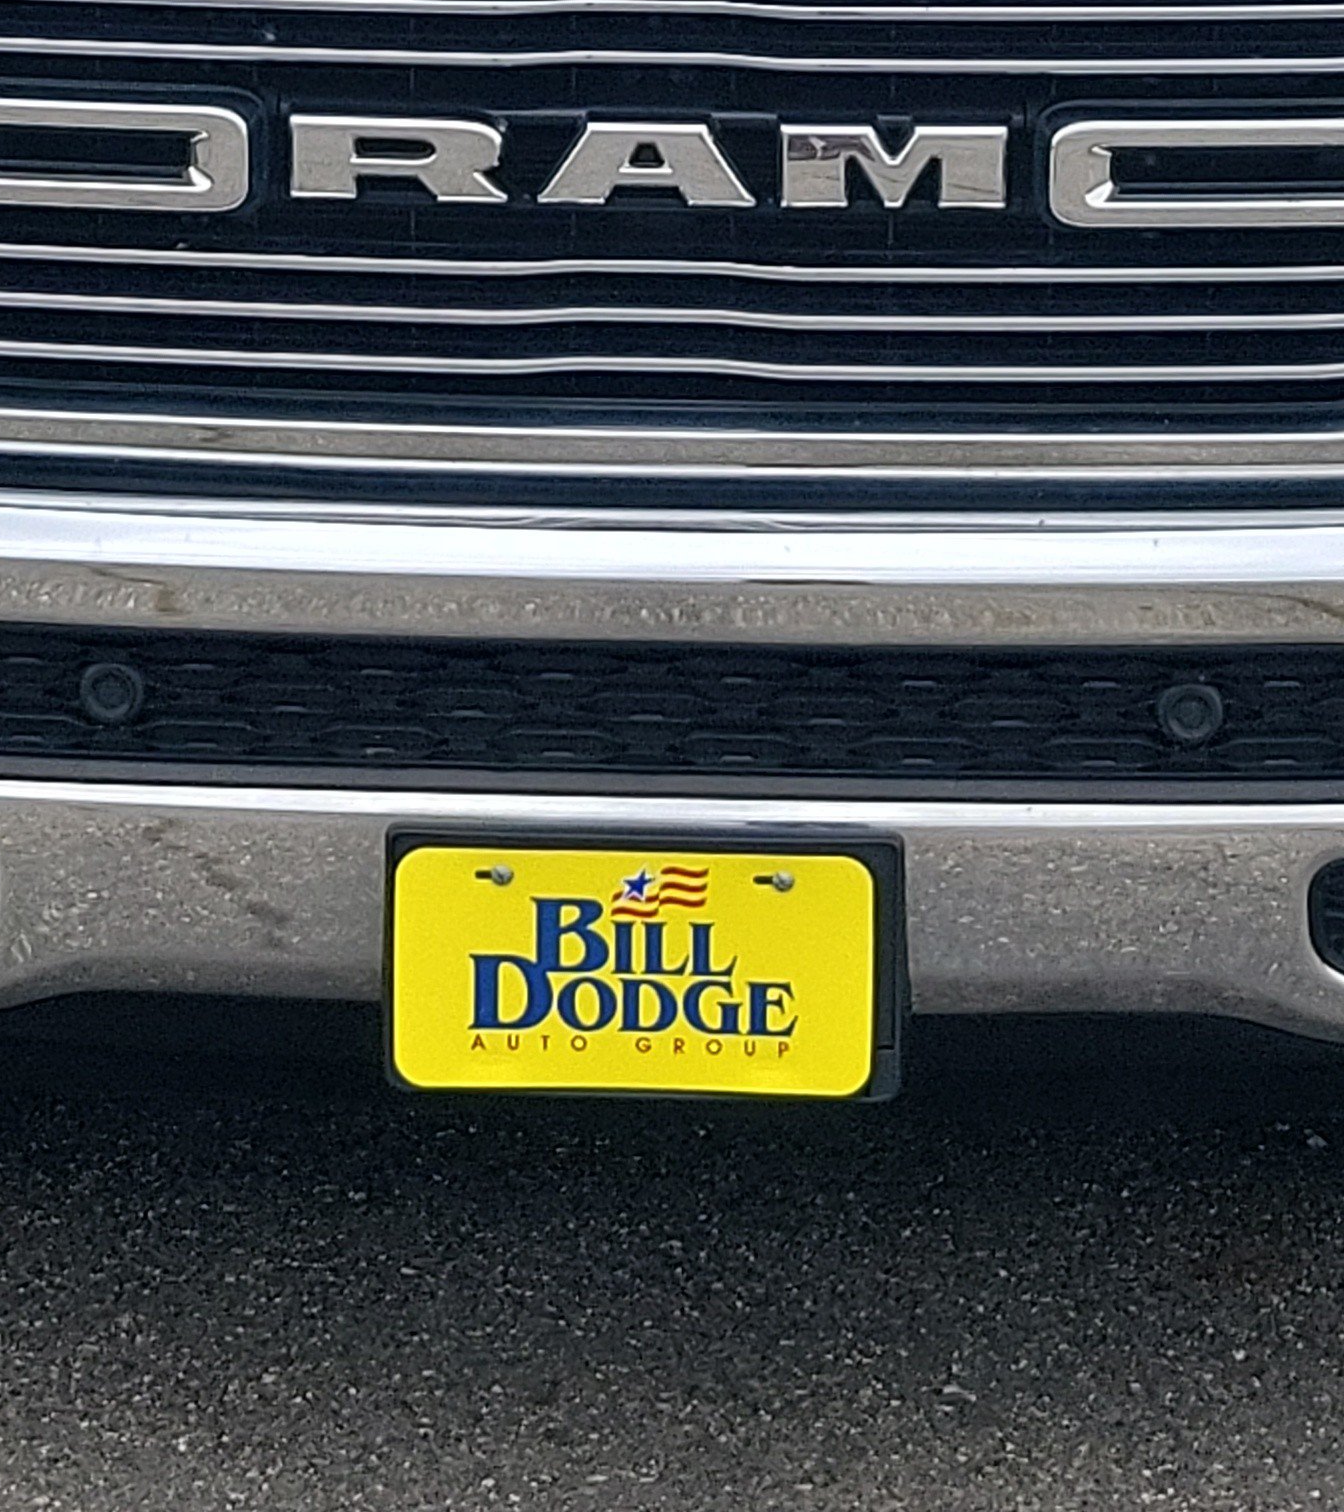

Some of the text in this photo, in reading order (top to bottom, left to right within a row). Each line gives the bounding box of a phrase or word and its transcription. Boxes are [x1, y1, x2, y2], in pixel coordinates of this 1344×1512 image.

[289, 113, 1010, 209] RAM
[531, 896, 738, 977] BILL
[468, 953, 799, 1038] DODGE
[470, 1035, 792, 1059] AUTO GROUP
